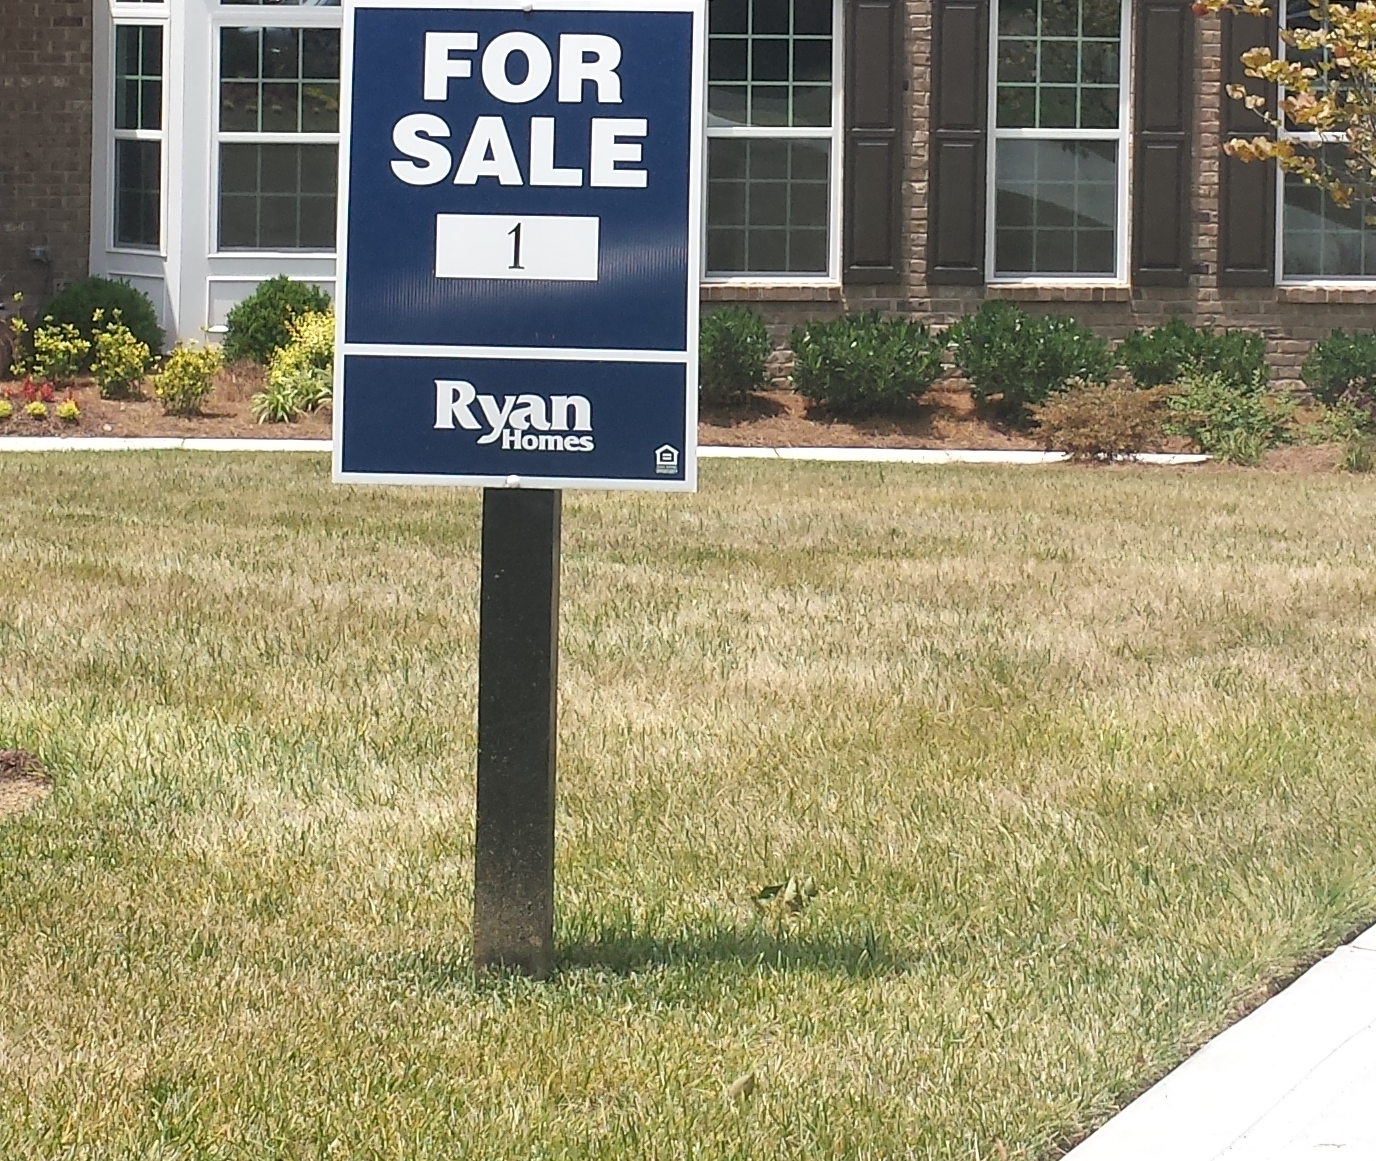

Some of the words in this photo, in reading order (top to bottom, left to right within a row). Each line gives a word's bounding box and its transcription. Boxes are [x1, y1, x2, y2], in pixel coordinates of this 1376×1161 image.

[423, 31, 623, 104] FOR
[390, 113, 648, 188] SALE
[507, 222, 524, 269] 1
[433, 380, 592, 444] Ryan
[502, 429, 594, 452] Homes
